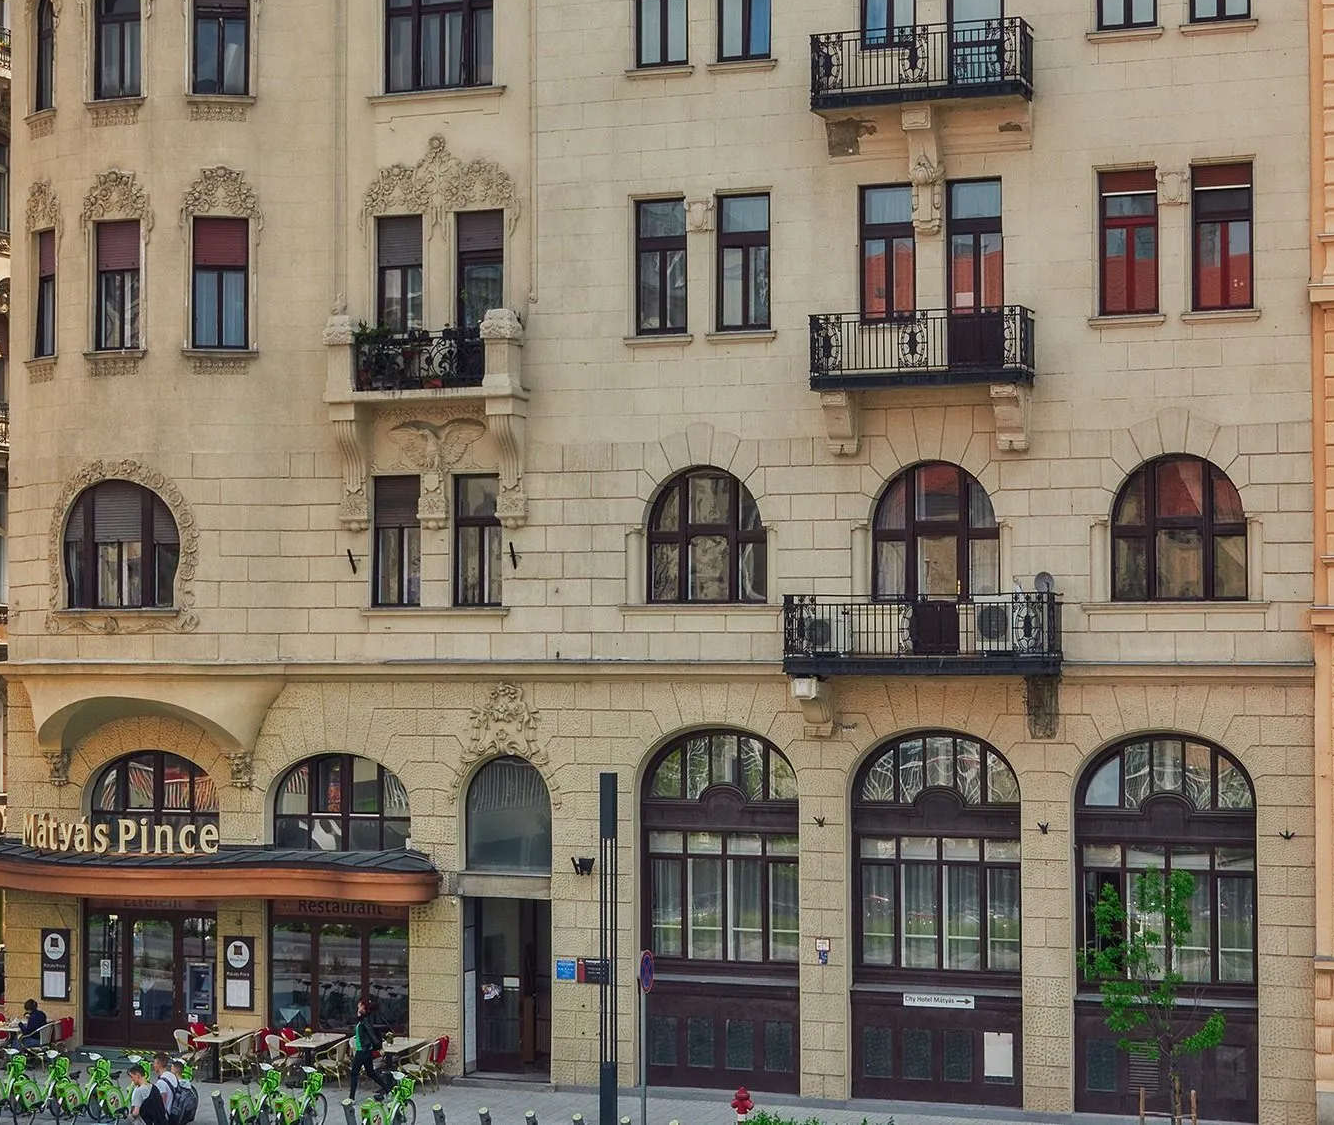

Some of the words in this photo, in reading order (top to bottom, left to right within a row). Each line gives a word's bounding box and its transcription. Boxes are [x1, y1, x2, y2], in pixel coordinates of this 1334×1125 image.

[22, 812, 111, 853] Mátyás
[117, 817, 219, 854] Pince
[298, 899, 383, 915] Restaurant
[904, 995, 916, 1003] City
